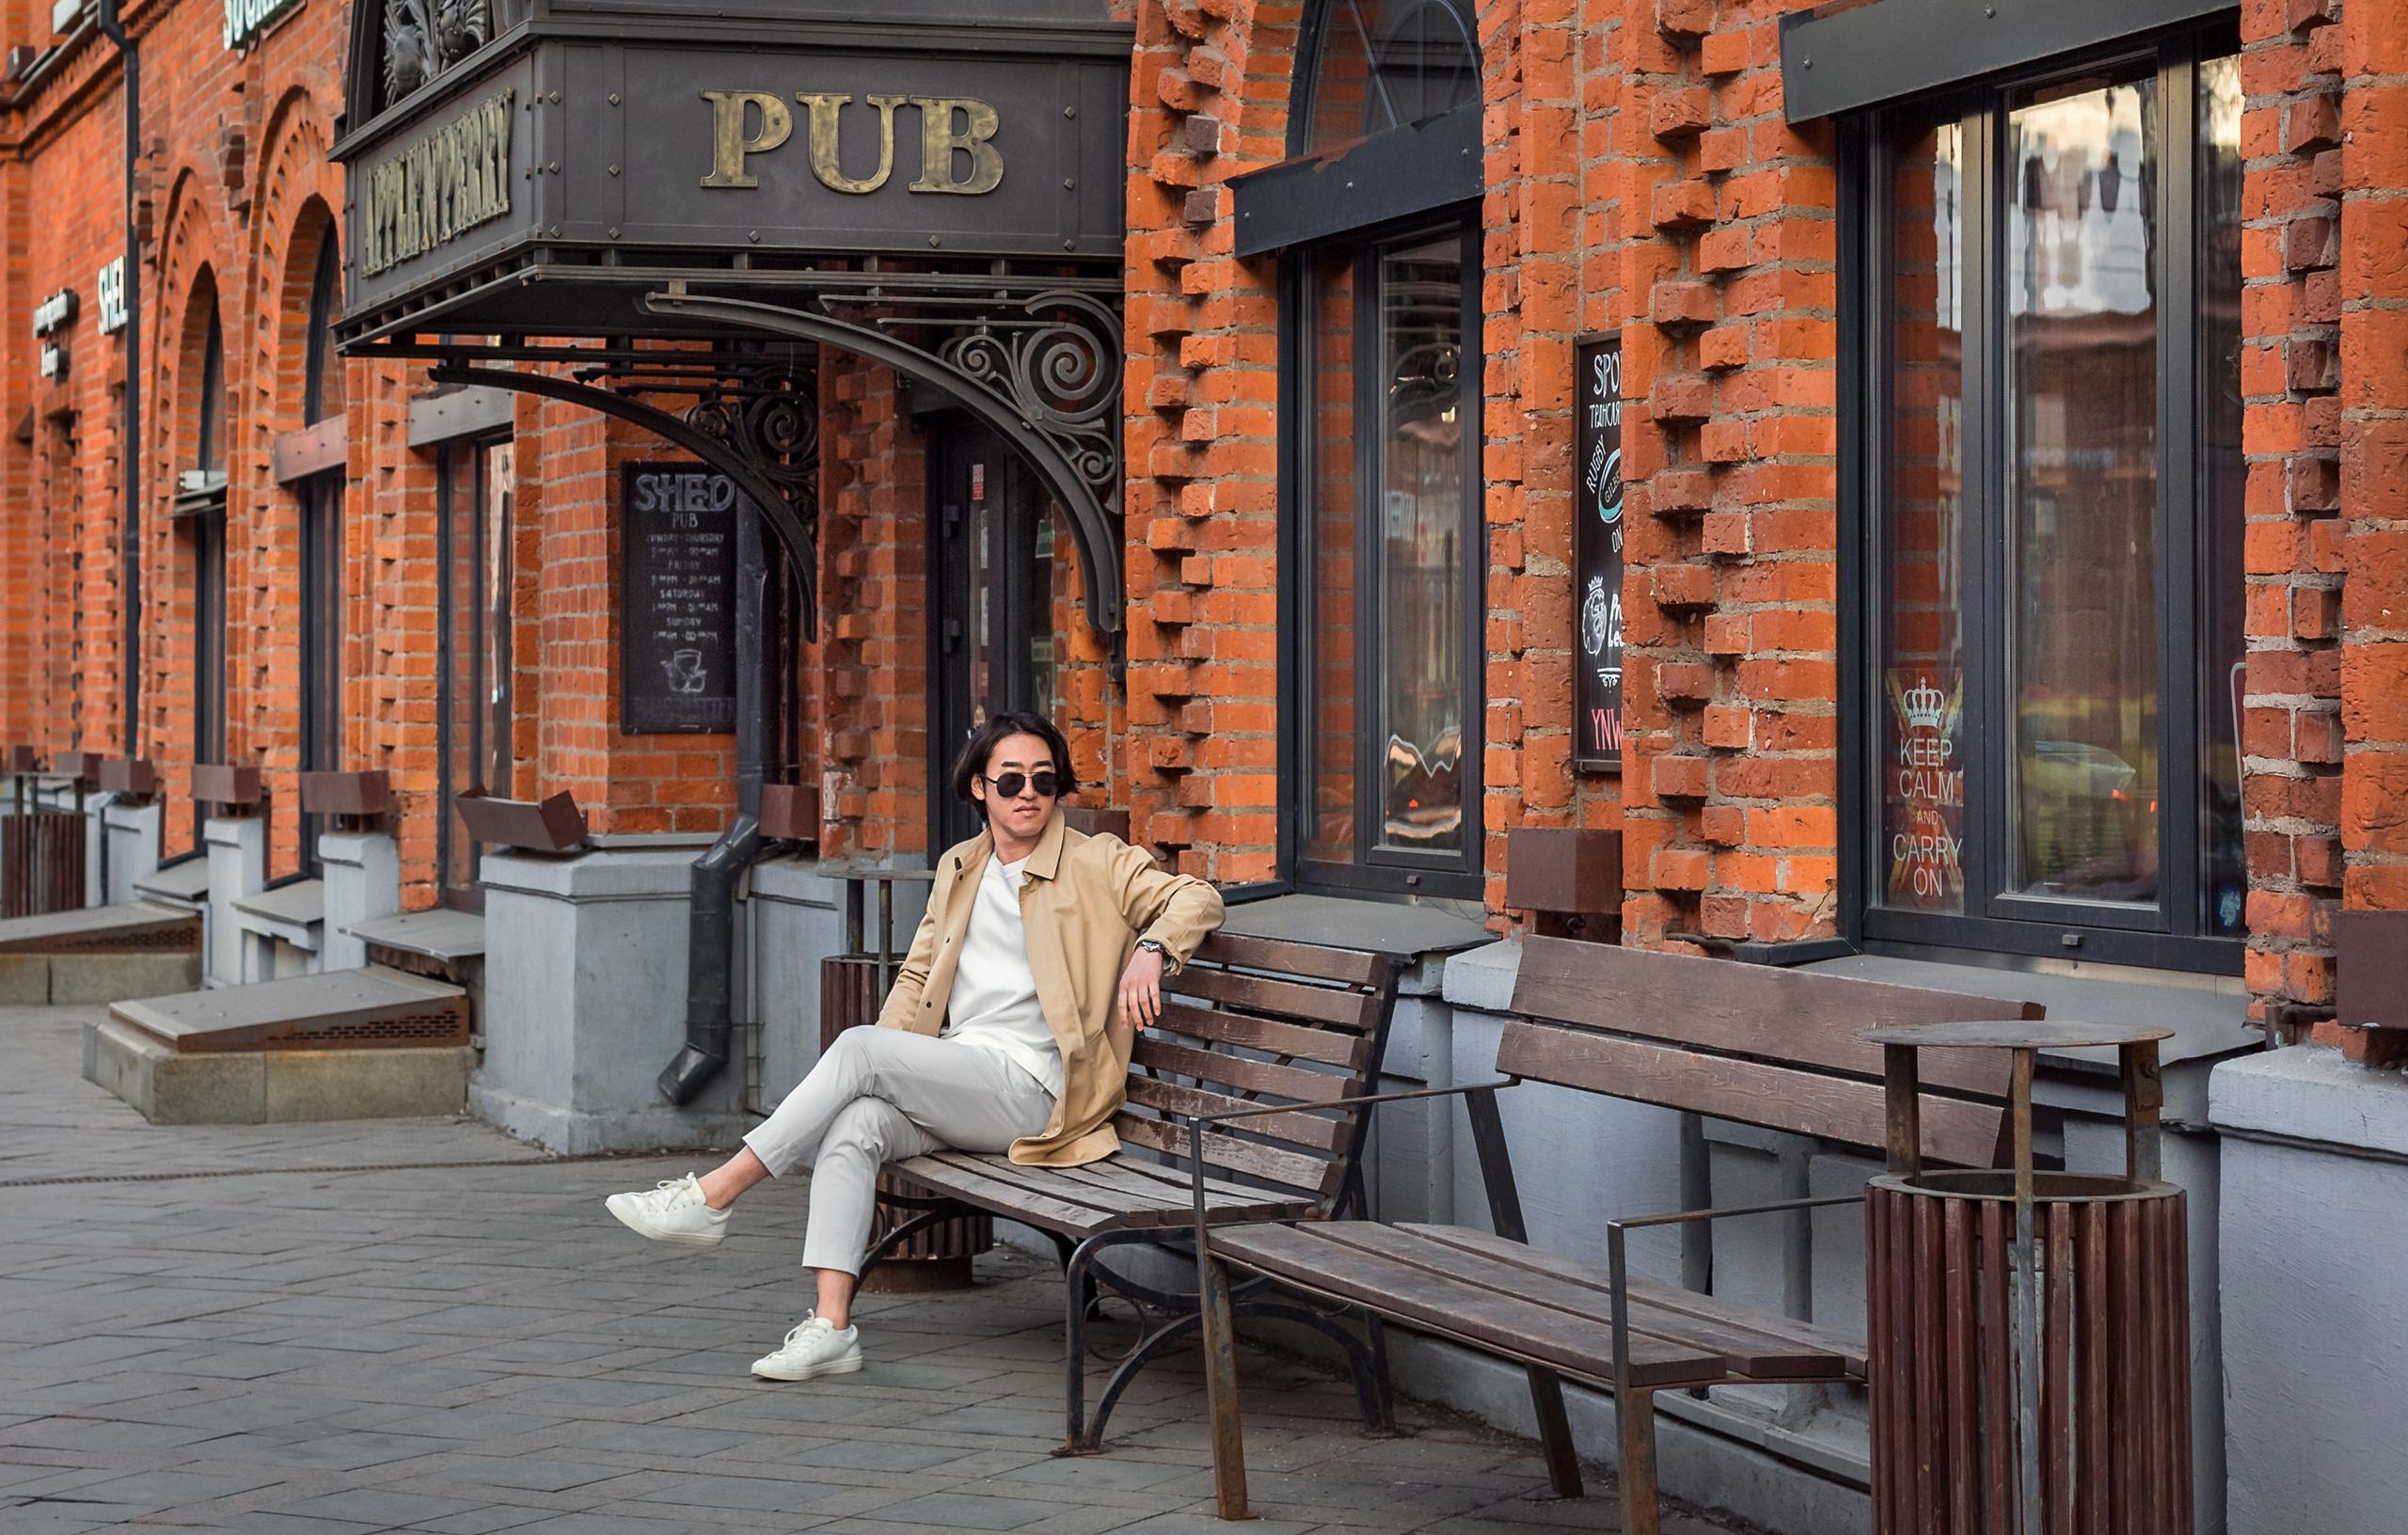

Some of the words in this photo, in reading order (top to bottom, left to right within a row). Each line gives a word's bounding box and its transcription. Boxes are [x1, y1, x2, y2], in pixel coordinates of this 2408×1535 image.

[699, 87, 1005, 195] PUB
[1589, 401, 1623, 429] ТРАНСЛЯ
[1586, 434, 1607, 495] RUGBY
[635, 473, 736, 512] SHED
[672, 513, 698, 529] PUB
[1900, 737, 1953, 767] KEEP
[1898, 769, 1954, 799] CALM
[1916, 810, 1939, 826] AND
[1893, 833, 1963, 866] CARRY
[1913, 866, 1942, 897] ON
